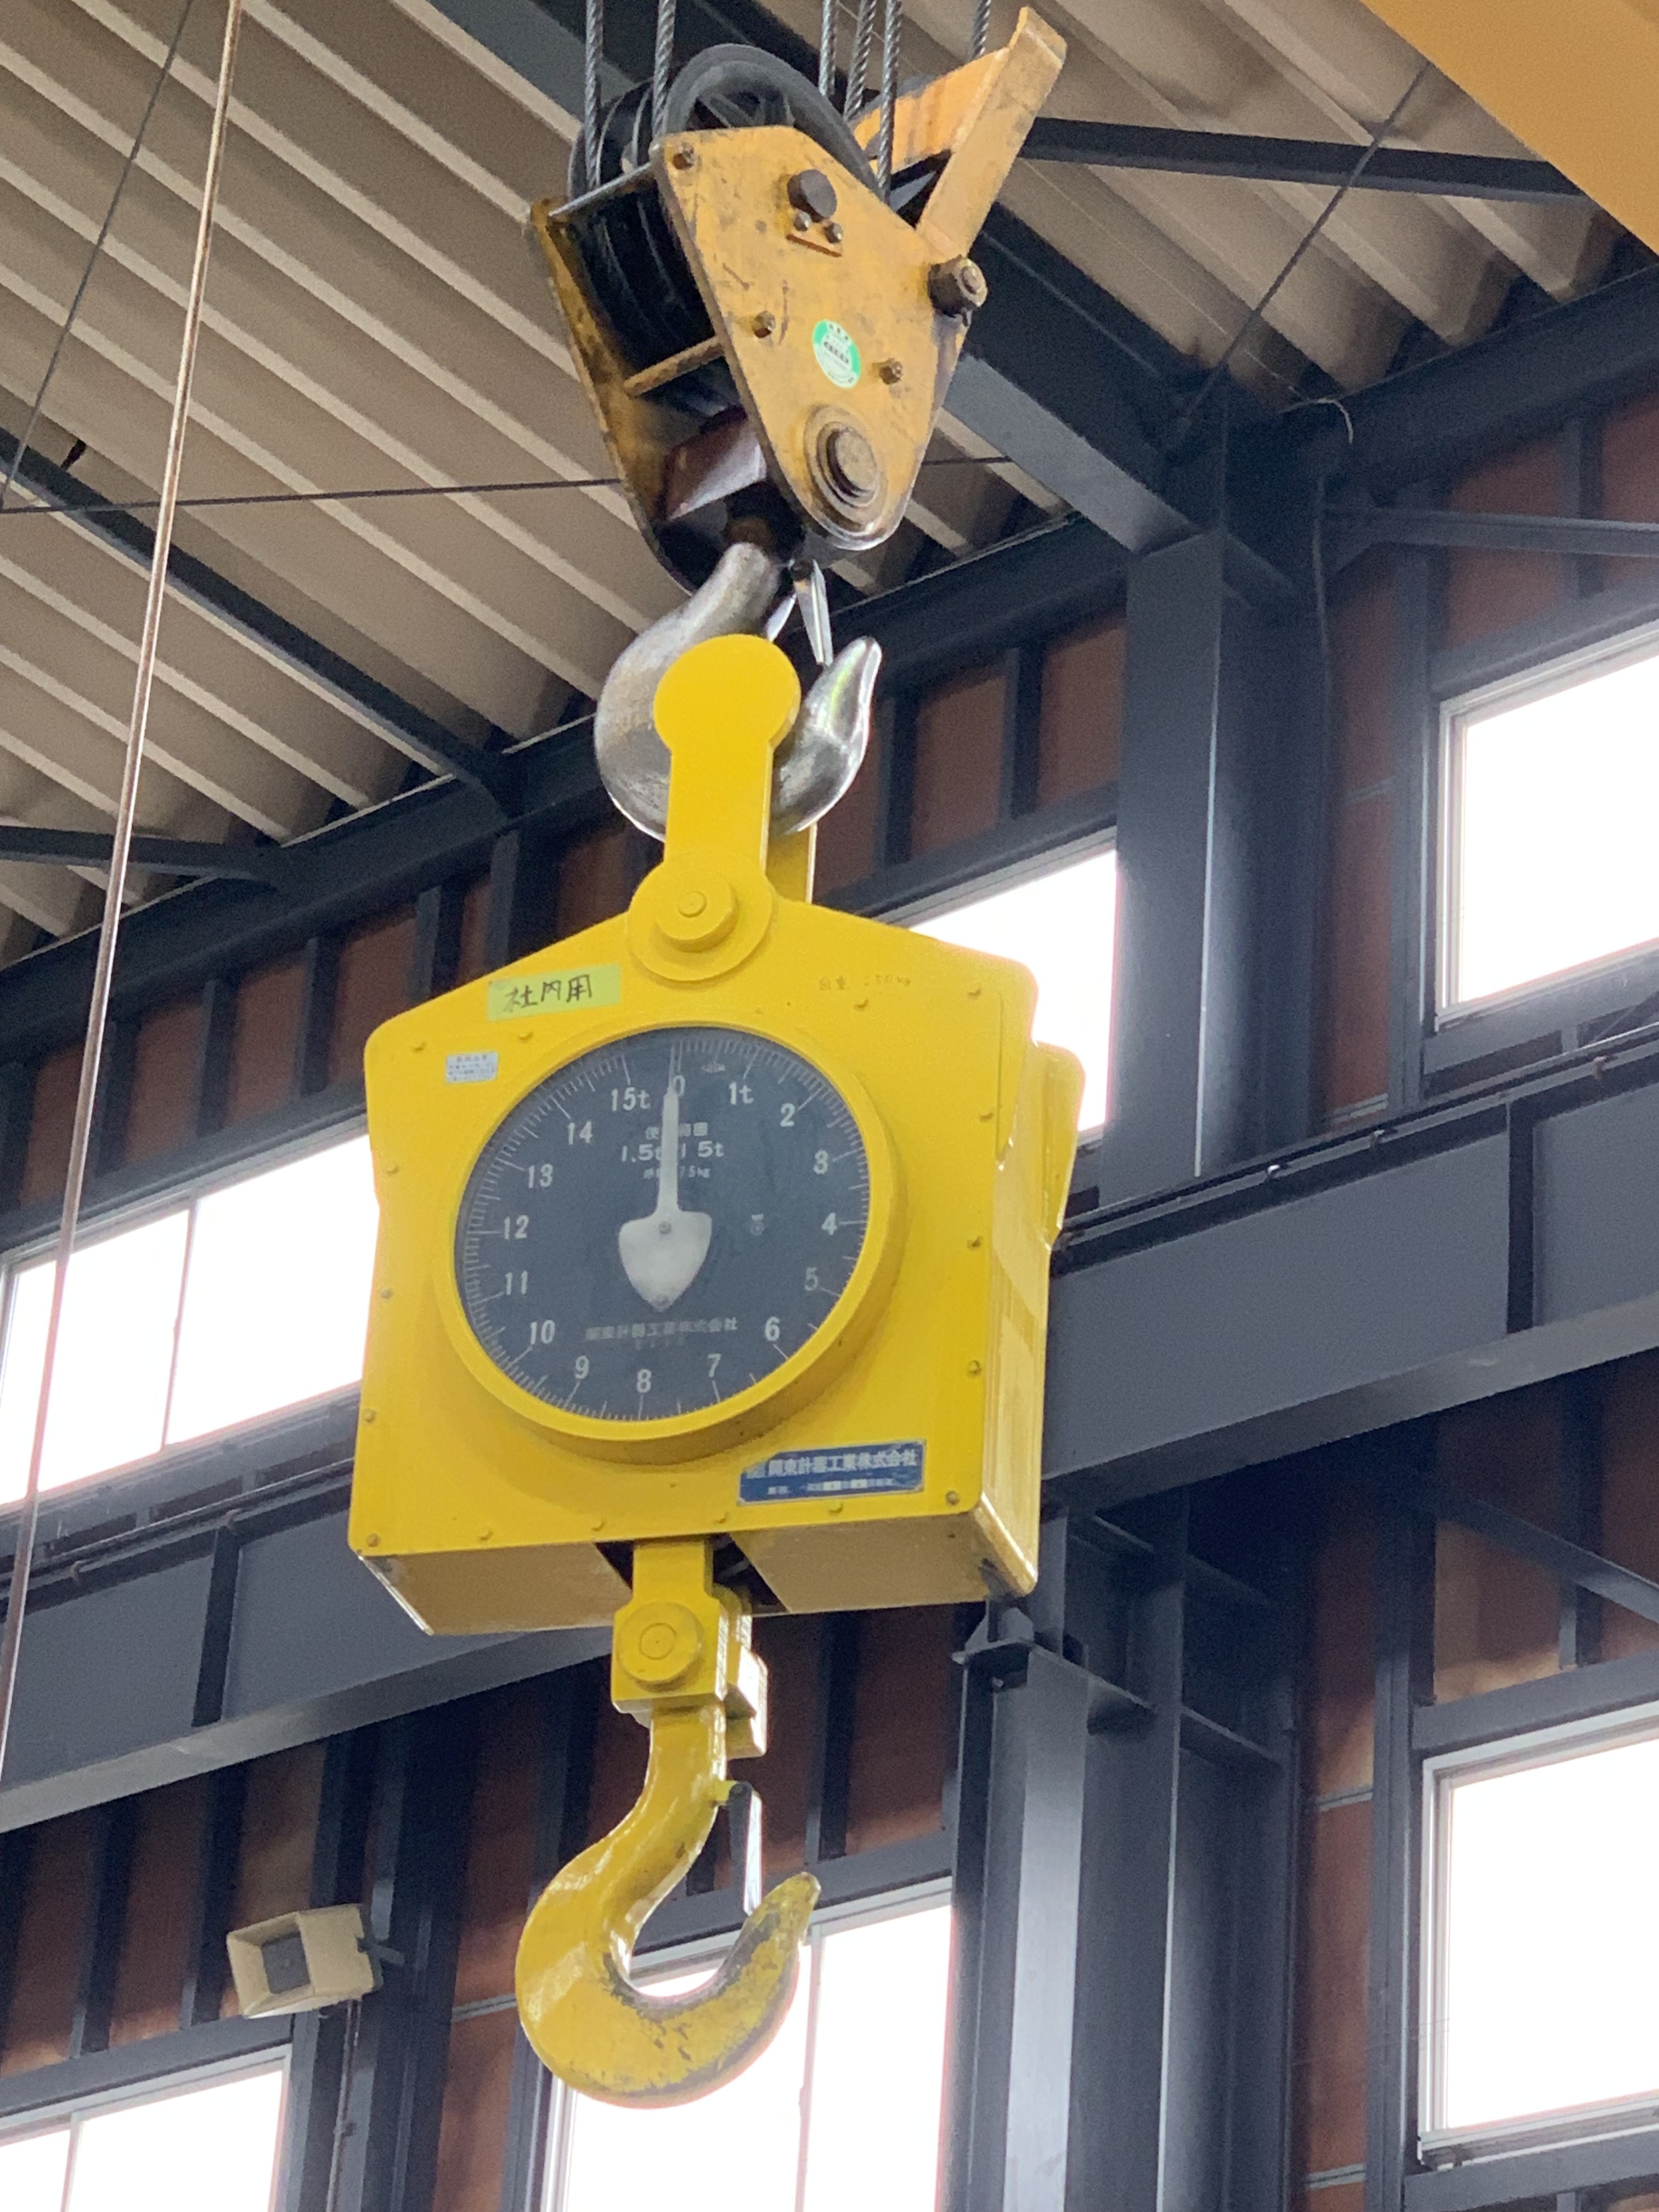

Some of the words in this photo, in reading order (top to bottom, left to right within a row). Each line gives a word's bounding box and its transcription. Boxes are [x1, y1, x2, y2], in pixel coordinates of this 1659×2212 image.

[503, 973, 593, 1013] 社内用
[611, 1087, 651, 1111] 15t
[729, 1082, 754, 1104] 1t
[780, 1103, 795, 1127] 2
[568, 1120, 593, 1146] 14
[528, 1164, 554, 1189] 13
[504, 1215, 529, 1240] 12
[821, 1212, 837, 1235] 4
[505, 1271, 528, 1296] 11
[804, 1267, 818, 1291] 5
[530, 1320, 555, 1344] 10
[765, 1317, 780, 1341] 6
[574, 1355, 589, 1379] 9
[708, 1353, 721, 1377] 7
[636, 1369, 652, 1393] 8
